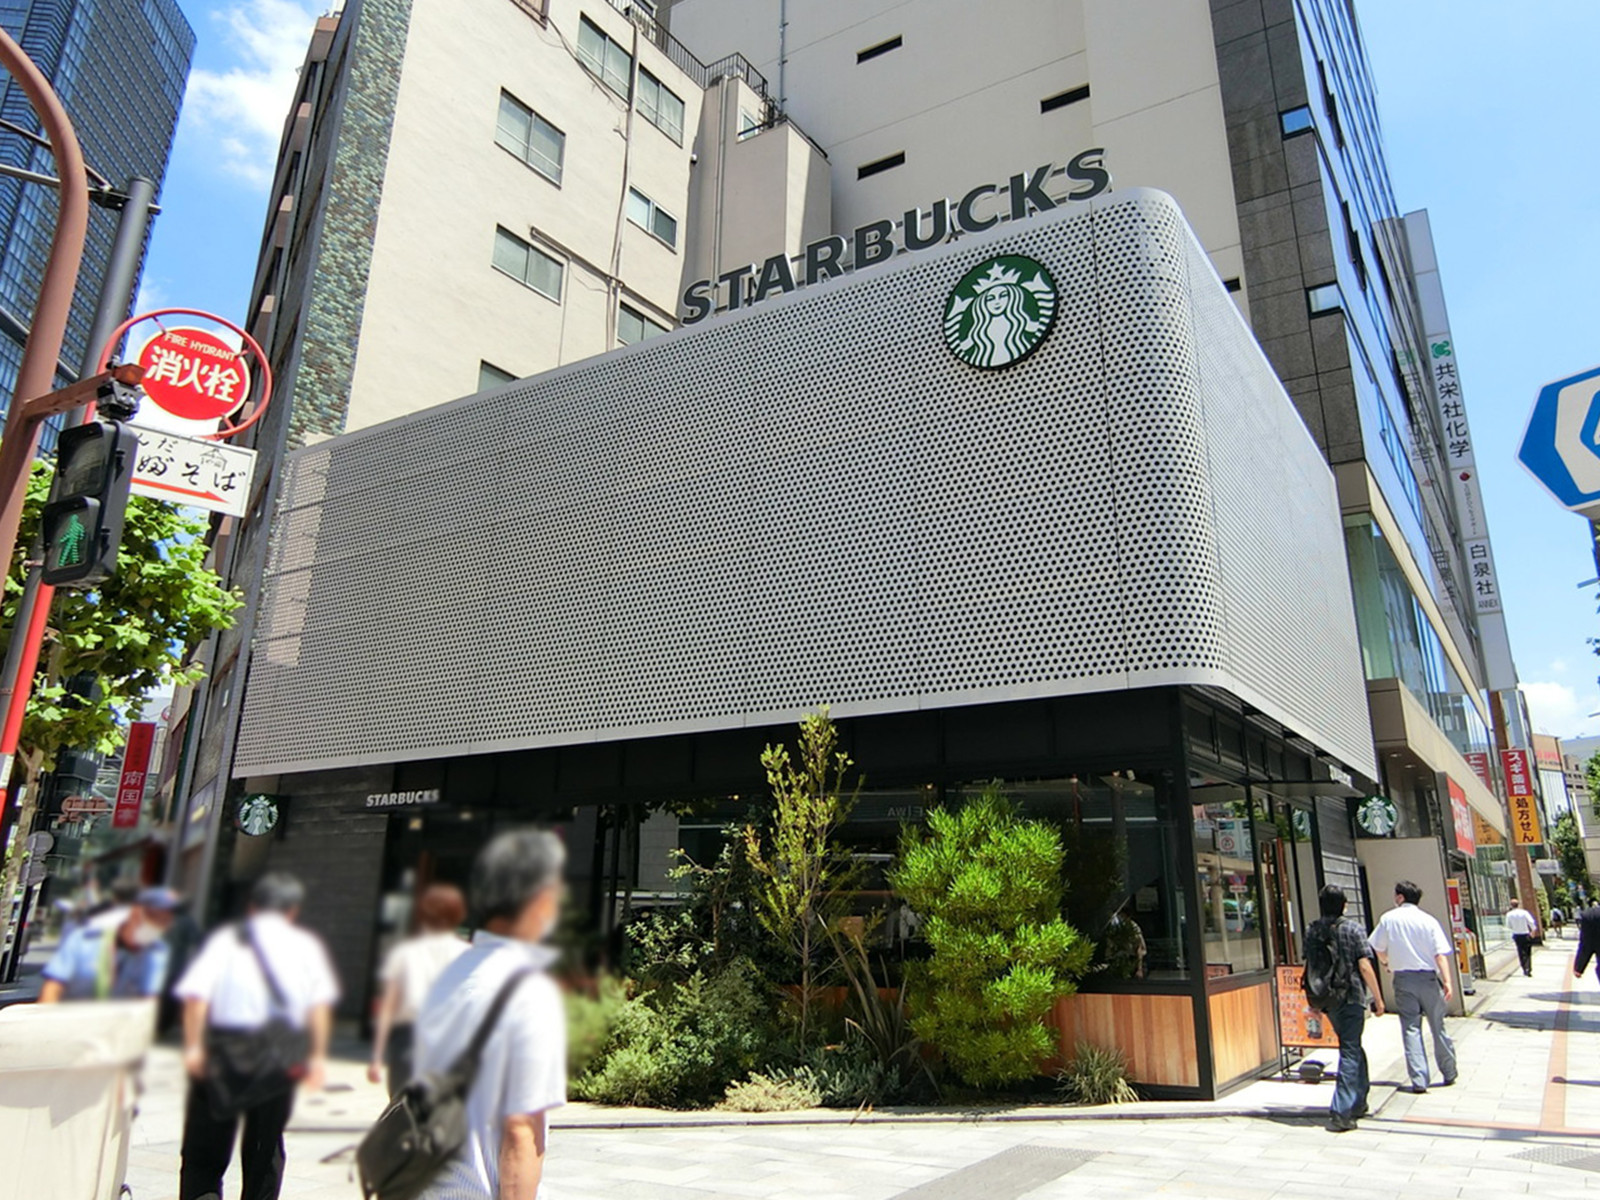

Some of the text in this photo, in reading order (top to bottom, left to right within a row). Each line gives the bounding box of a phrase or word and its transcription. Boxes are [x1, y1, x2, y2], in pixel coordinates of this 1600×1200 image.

[681, 147, 1114, 326] STARBUCKS
[164, 332, 237, 362] FIRE HYDRANT
[145, 345, 241, 403] 消火栓
[1435, 362, 1470, 458] 共栄社化学
[1470, 544, 1495, 595] 白泉社
[366, 789, 440, 807] STARBUCKS
[1515, 797, 1535, 843] 処方せん
